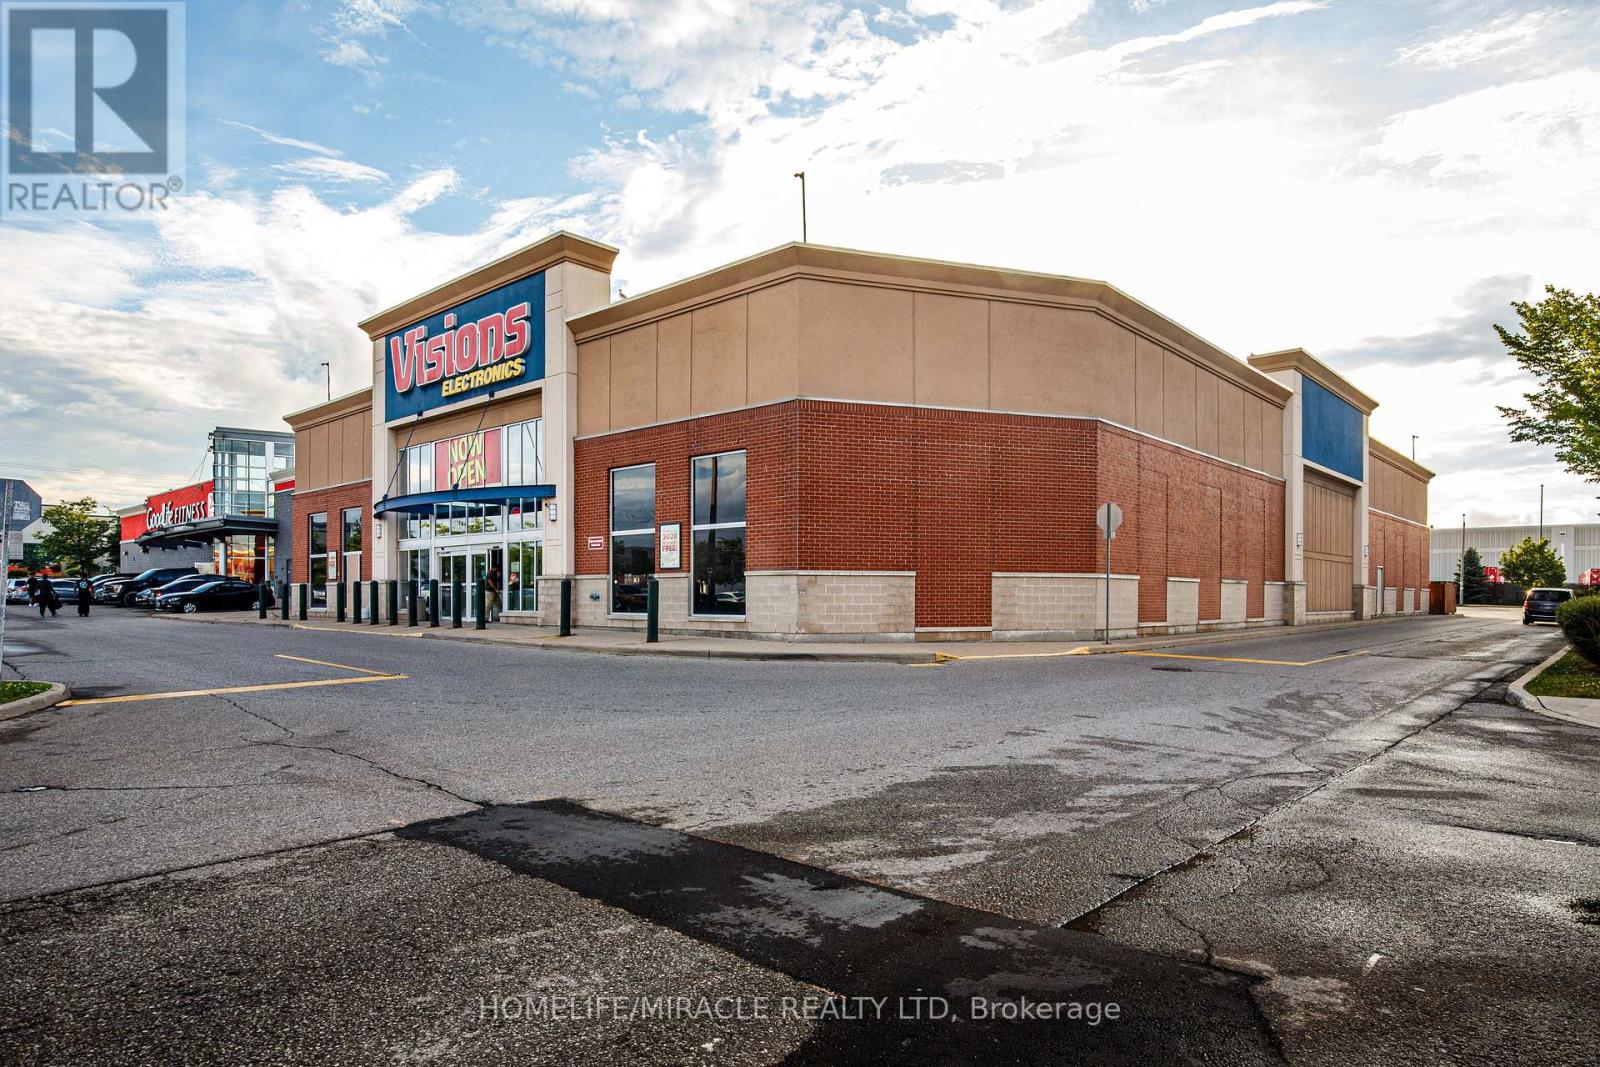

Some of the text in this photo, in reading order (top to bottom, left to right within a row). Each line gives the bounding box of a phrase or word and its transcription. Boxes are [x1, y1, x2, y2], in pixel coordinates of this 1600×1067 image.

[390, 302, 531, 393] Visions
[441, 358, 525, 397] ELECTRONICS
[450, 432, 484, 463] NOW
[448, 458, 487, 489] OPEN
[174, 501, 206, 526] FITNESS
